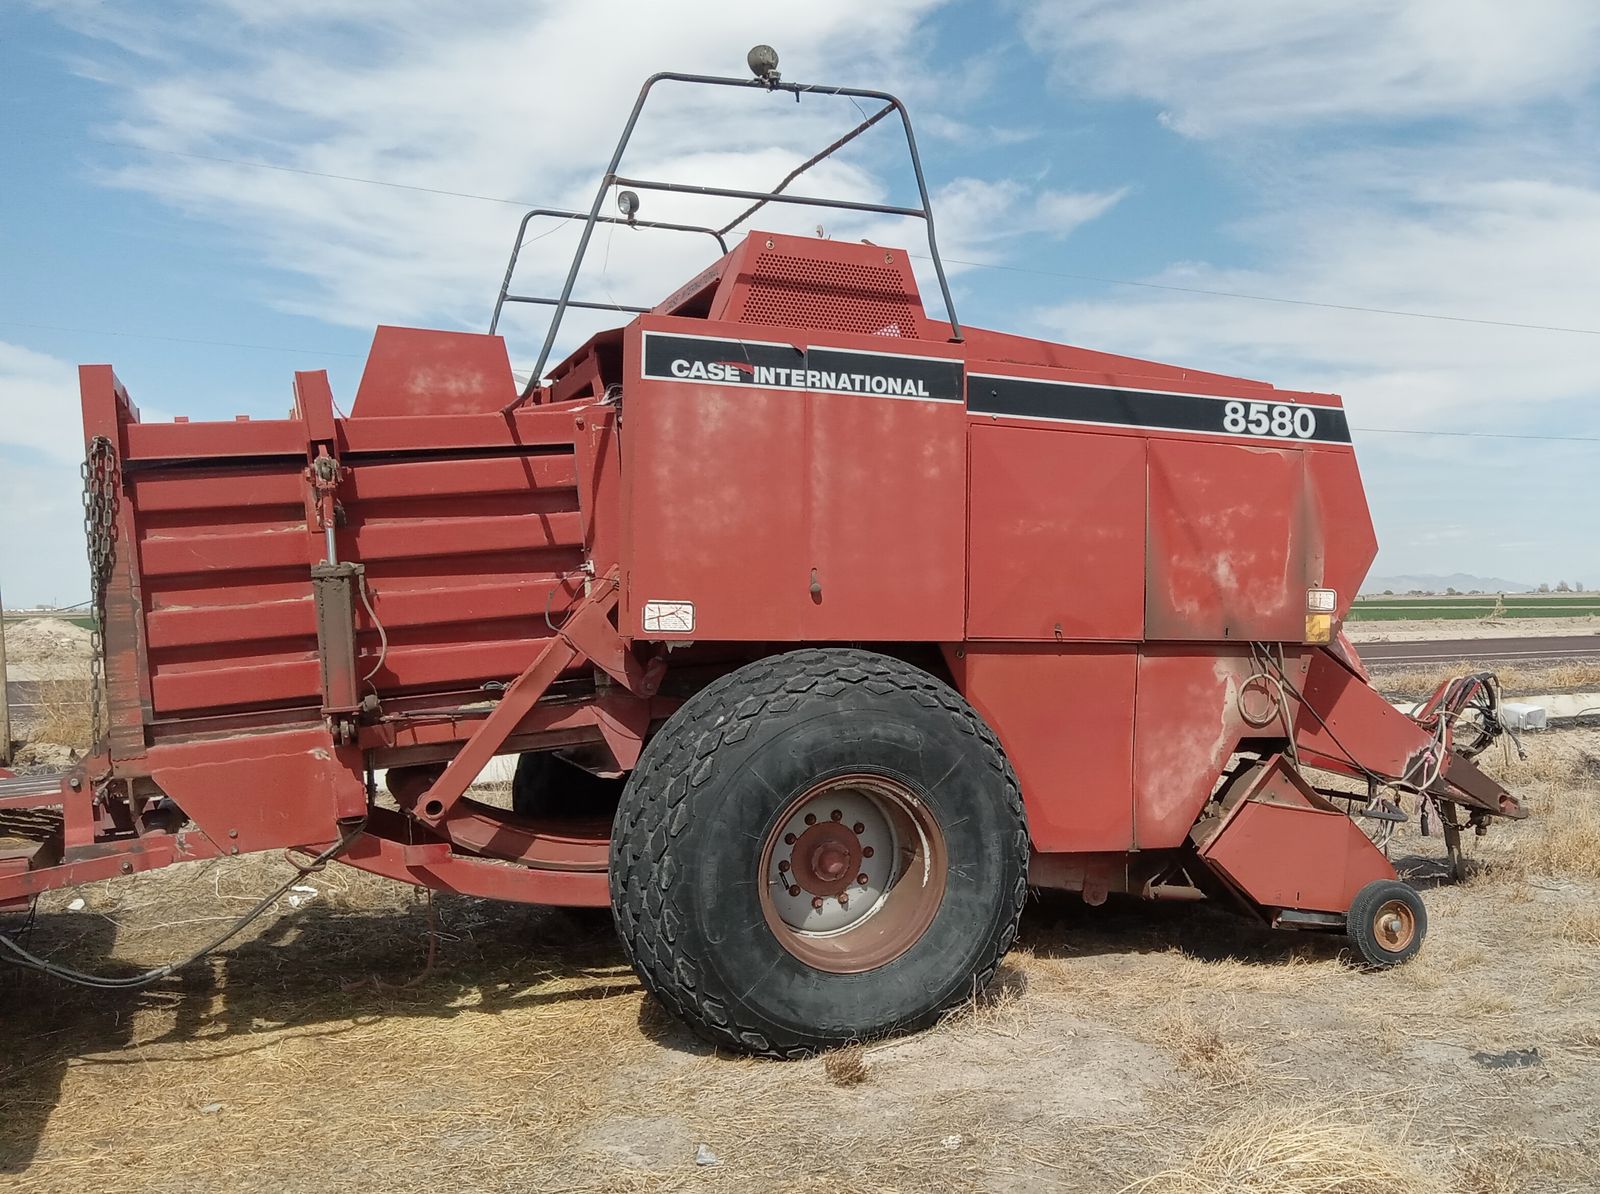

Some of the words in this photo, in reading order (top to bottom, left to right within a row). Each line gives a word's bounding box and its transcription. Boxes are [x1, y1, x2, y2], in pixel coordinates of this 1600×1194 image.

[671, 359, 741, 382] CASE
[753, 365, 930, 397] INTERNATIONAL
[1223, 401, 1317, 439] 8580
